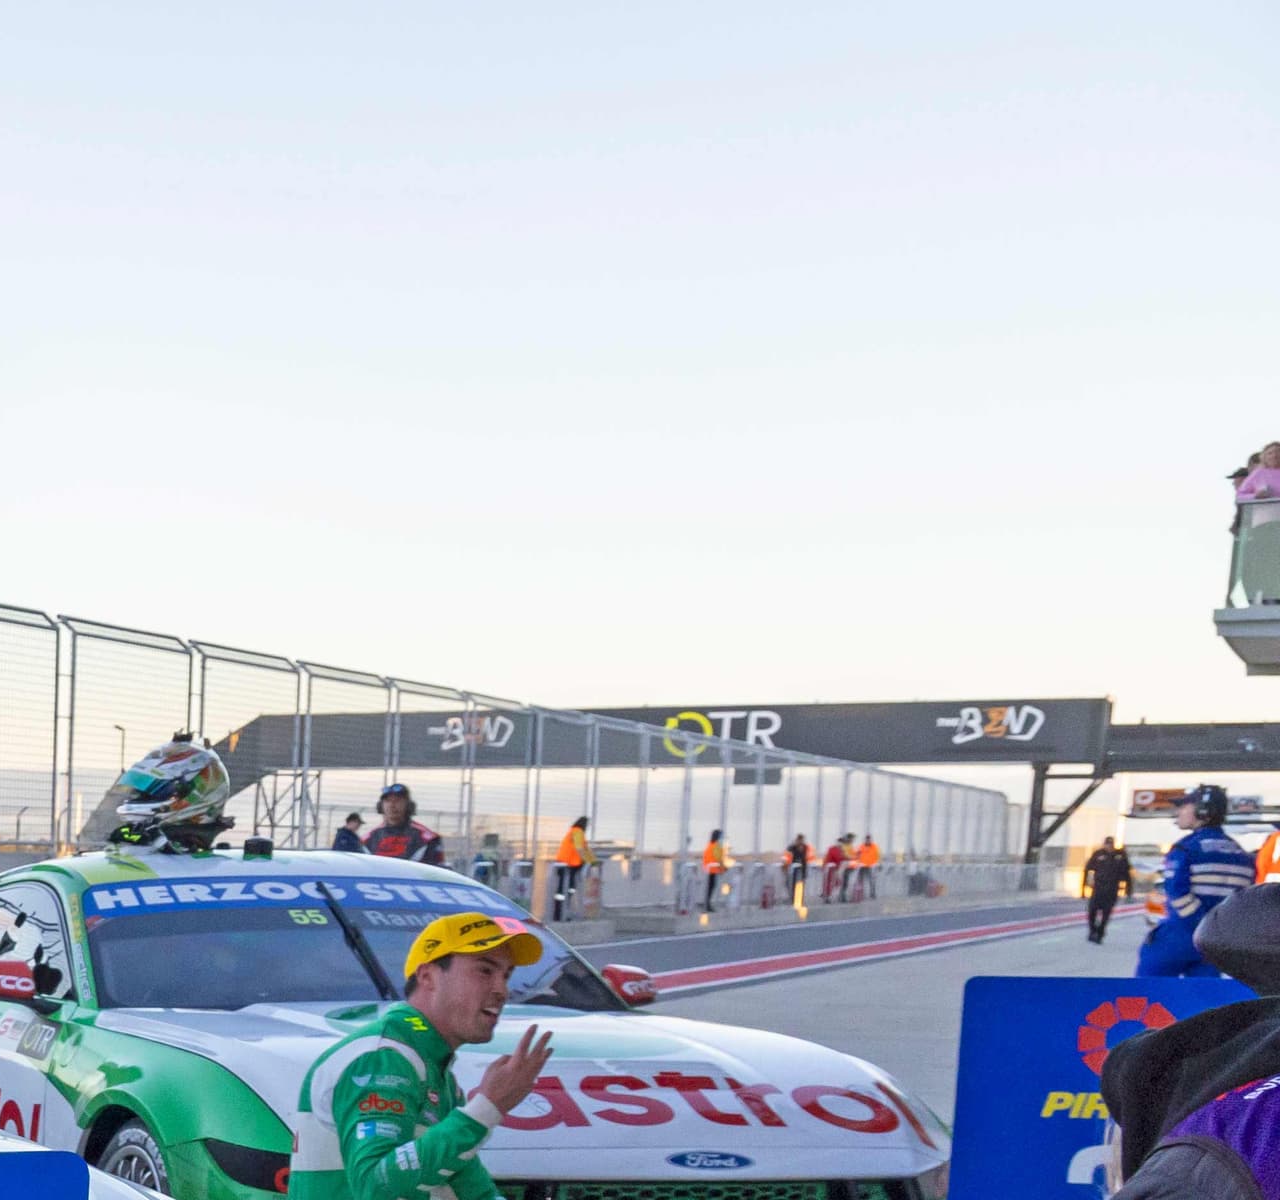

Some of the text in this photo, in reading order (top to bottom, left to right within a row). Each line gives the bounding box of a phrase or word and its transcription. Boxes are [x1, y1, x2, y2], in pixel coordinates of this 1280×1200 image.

[92, 881, 508, 911] HERZOG STEEL
[288, 909, 329, 925] 55
[359, 1094, 405, 1114] dba
[496, 1072, 938, 1151] astrol
[1040, 1091, 1110, 1119] PIR
[681, 1152, 743, 1169] Ford
